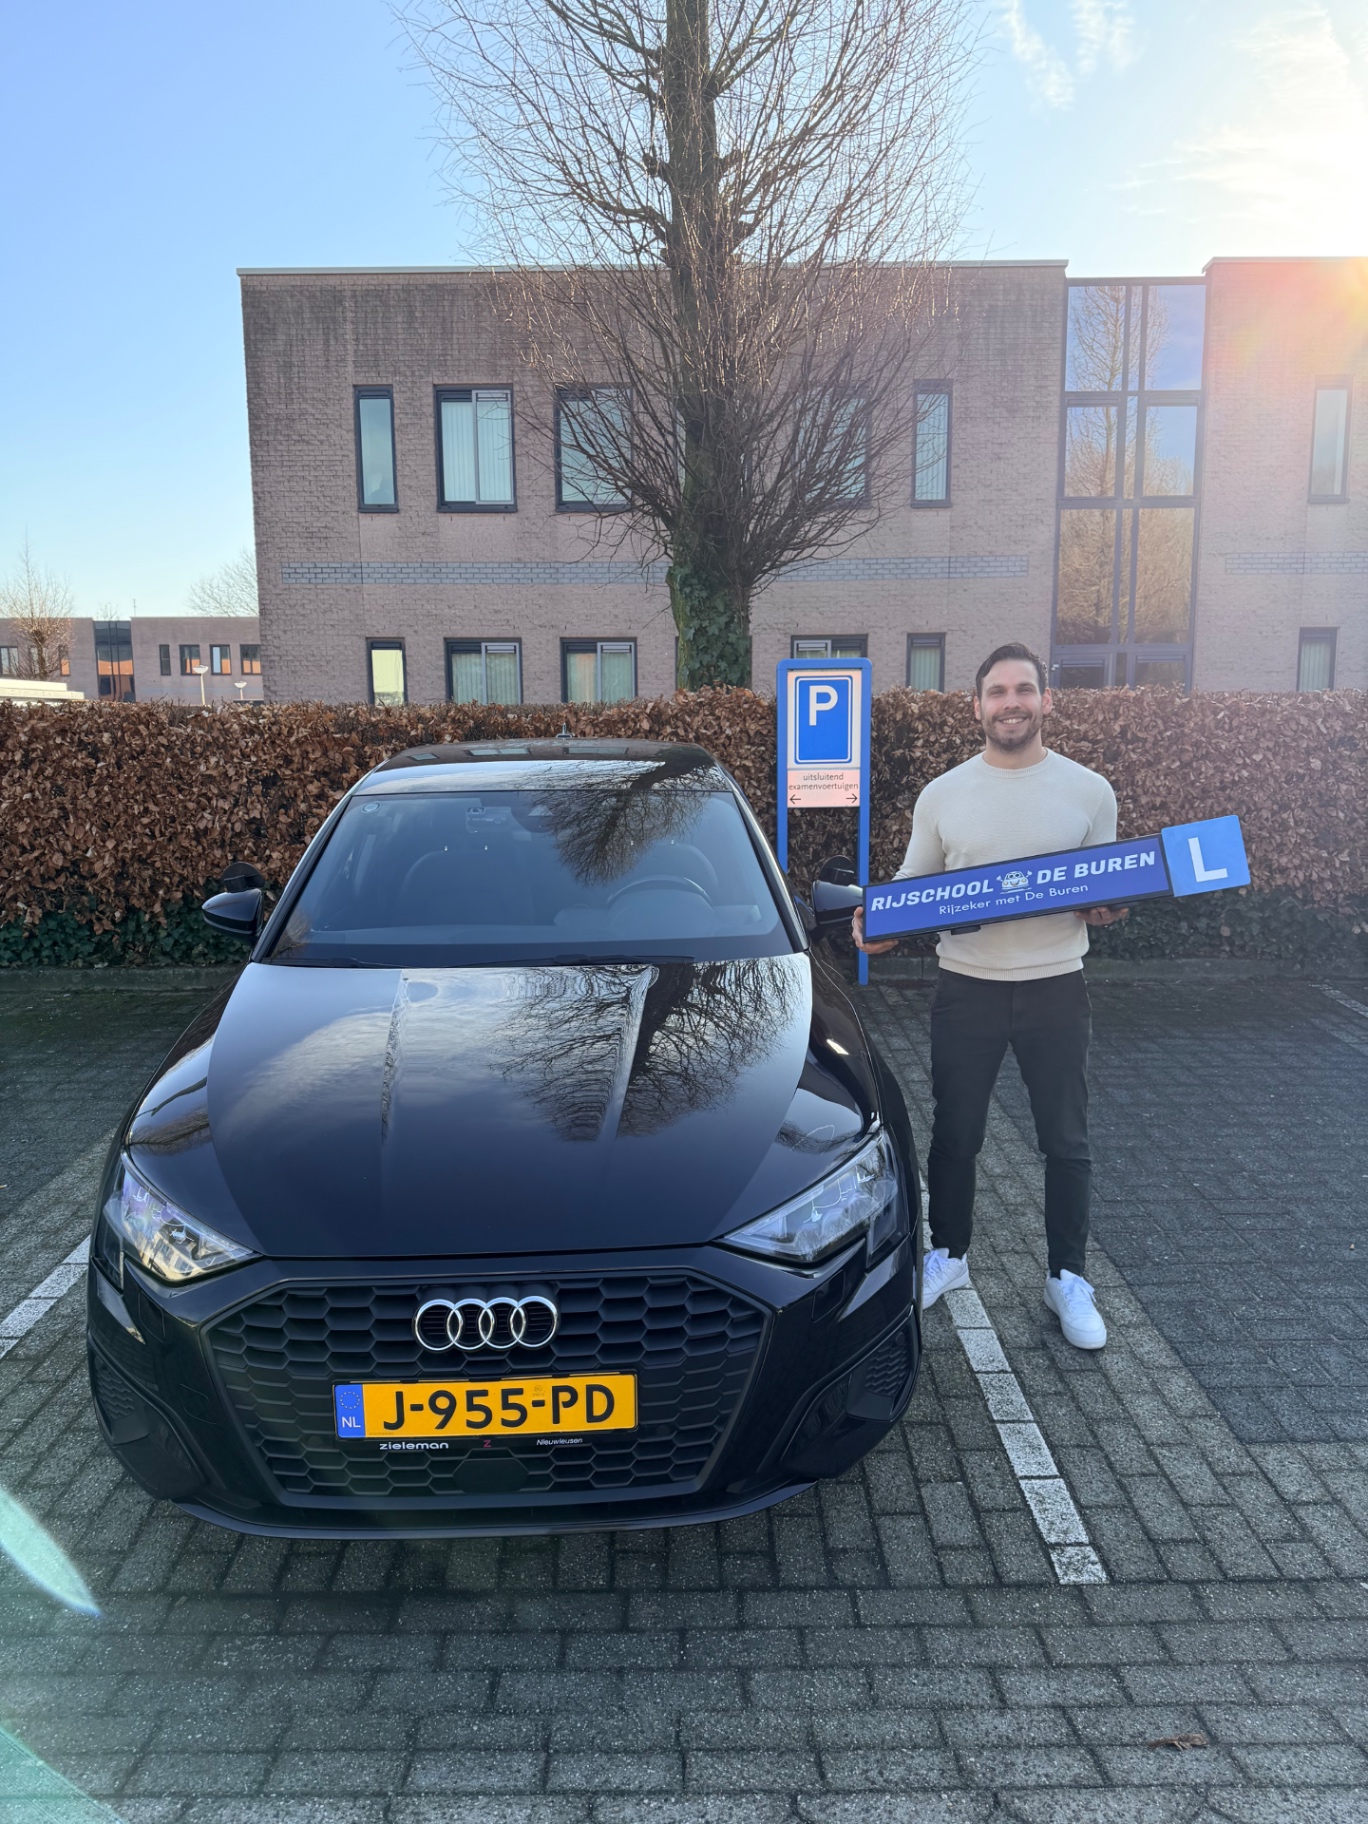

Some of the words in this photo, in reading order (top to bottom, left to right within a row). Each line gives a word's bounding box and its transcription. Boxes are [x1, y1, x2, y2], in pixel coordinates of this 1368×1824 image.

[808, 684, 839, 727] P
[788, 782, 859, 791] examenvoertuigen
[802, 772, 844, 781] uitsluitend
[1188, 837, 1228, 883] L
[870, 879, 994, 911] RIJSCHOOL
[1036, 866, 1067, 885] DE
[1073, 850, 1156, 879] BUREN
[939, 900, 991, 915] Rijzeker
[995, 895, 1020, 906] met
[1024, 891, 1044, 901] De
[1049, 884, 1089, 897] Buren
[341, 1416, 361, 1428] NL
[383, 1384, 615, 1431] J-955-PD
[379, 1441, 449, 1450] zieleman
